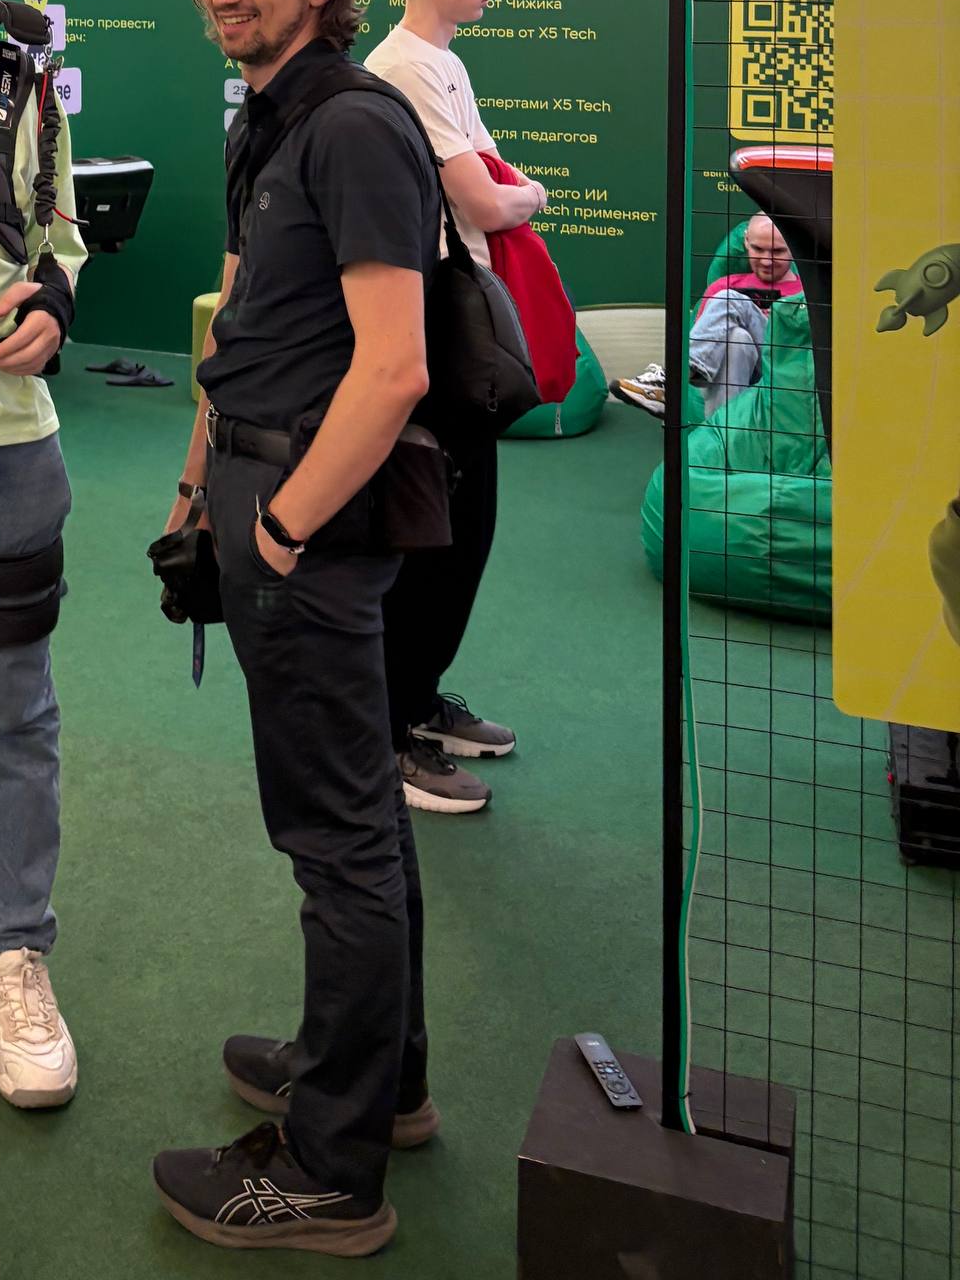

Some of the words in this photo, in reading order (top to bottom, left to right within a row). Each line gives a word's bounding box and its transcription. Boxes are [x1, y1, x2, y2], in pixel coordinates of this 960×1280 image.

[486, 0, 502, 9] от
[65, 17, 95, 28] ятно
[97, 19, 156, 30] провести
[454, 24, 514, 40] роботов
[518, 28, 535, 38] от
[538, 26, 558, 40] X5
[561, 27, 597, 41] Tech
[553, 98, 572, 111] X5
[576, 99, 611, 113] Tech
[492, 128, 517, 141] для
[522, 130, 598, 144] педагогов
[585, 188, 608, 201] ИИ
[539, 203, 570, 217] ech
[574, 207, 658, 222] применяет
[560, 222, 624, 237] дальше»
